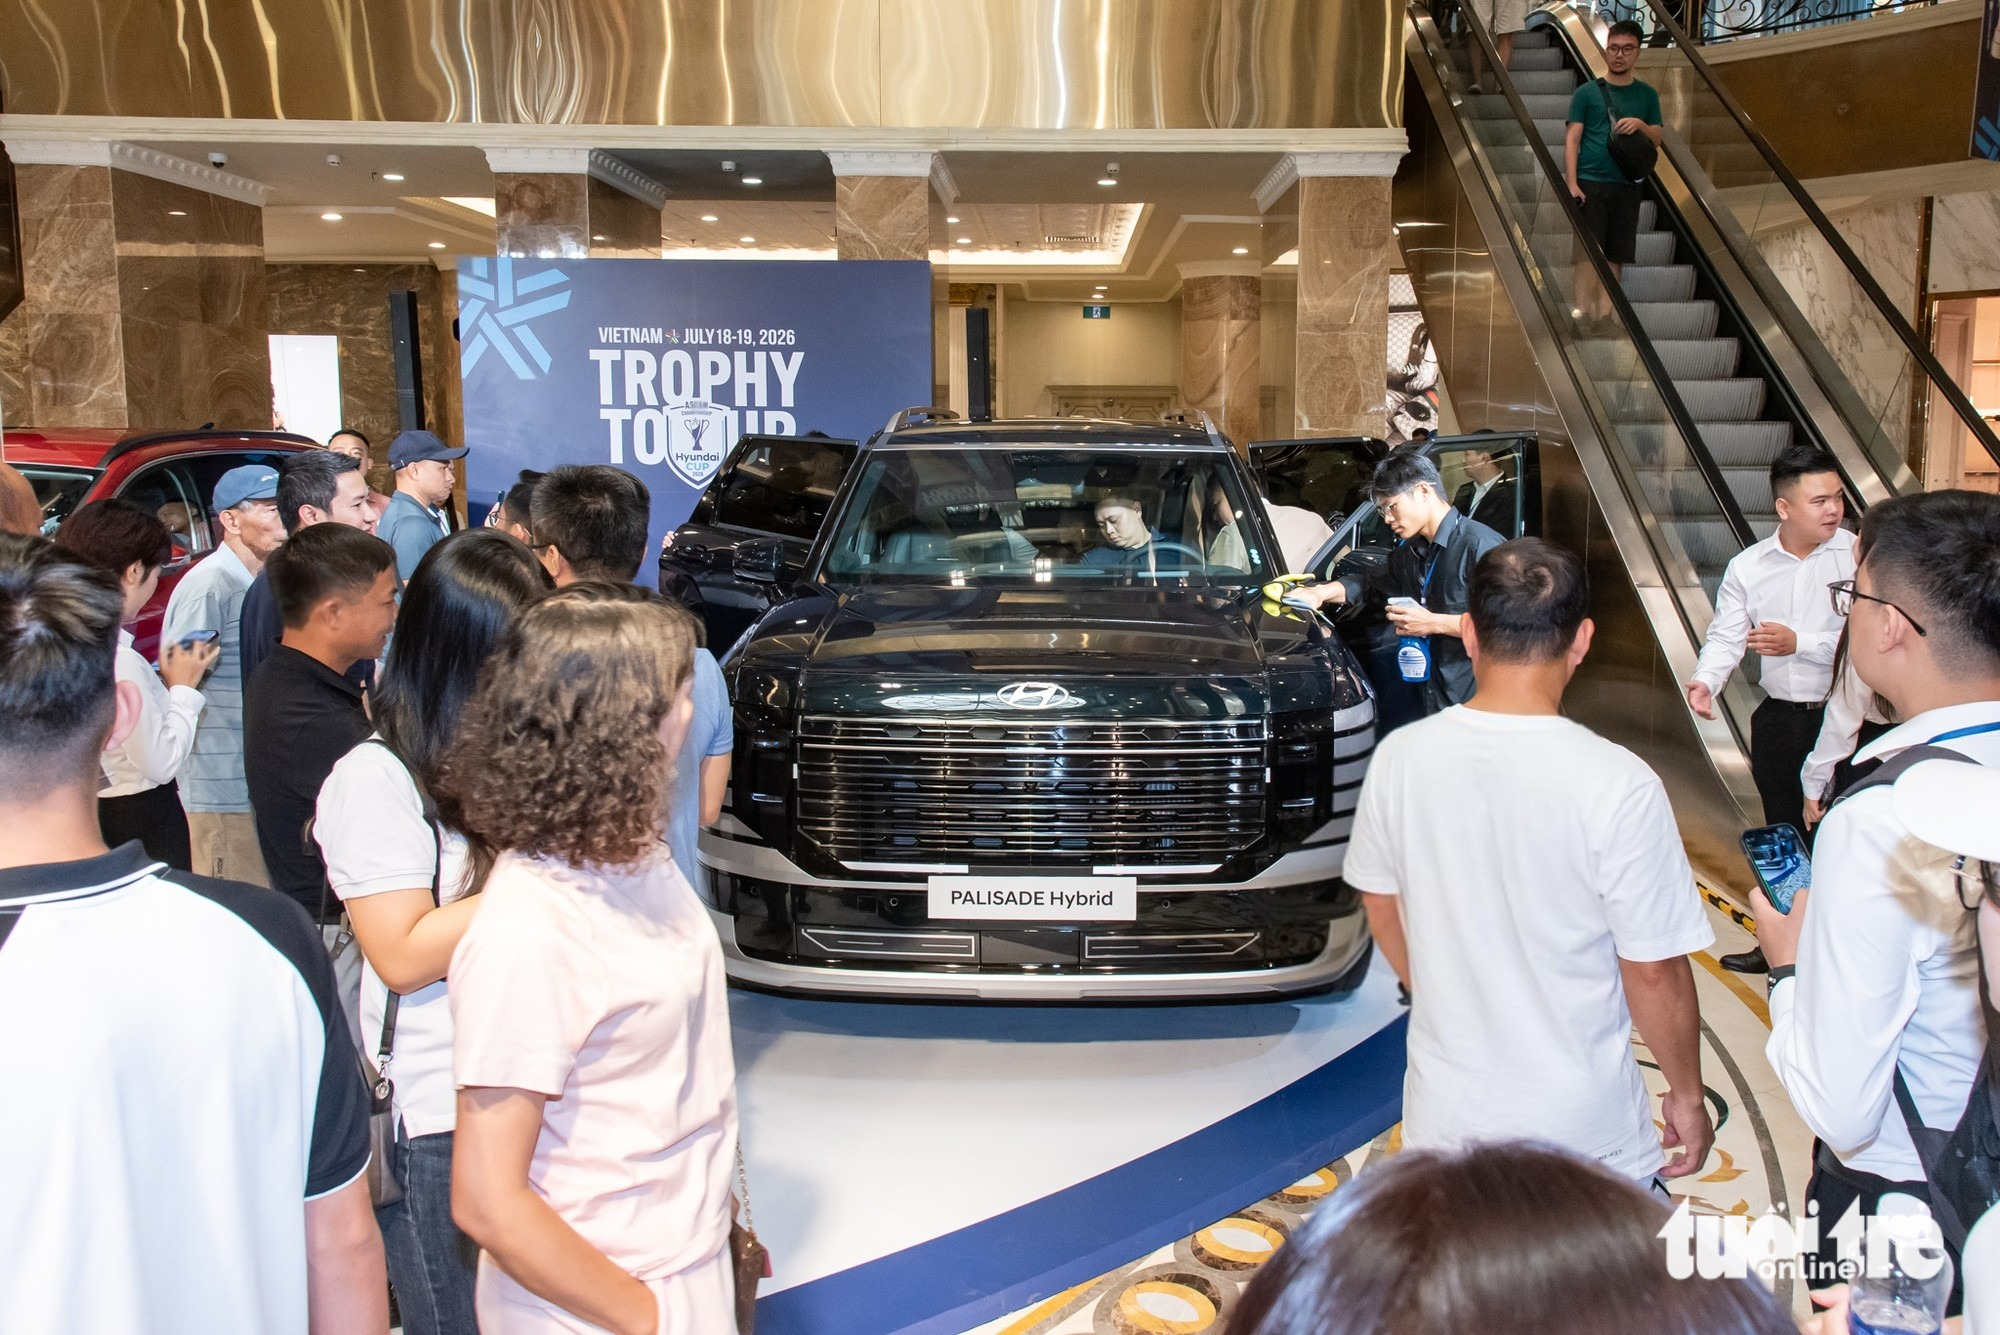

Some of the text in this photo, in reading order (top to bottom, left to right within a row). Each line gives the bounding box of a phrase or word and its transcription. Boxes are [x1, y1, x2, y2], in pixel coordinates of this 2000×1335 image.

[598, 327, 796, 347] VIETNAM JULY 18-19, 2026
[589, 349, 805, 407] TROPHY
[675, 452, 720, 463] Hyundai
[685, 462, 710, 472] CUP
[951, 890, 1114, 909] PALISADE Hybrid
